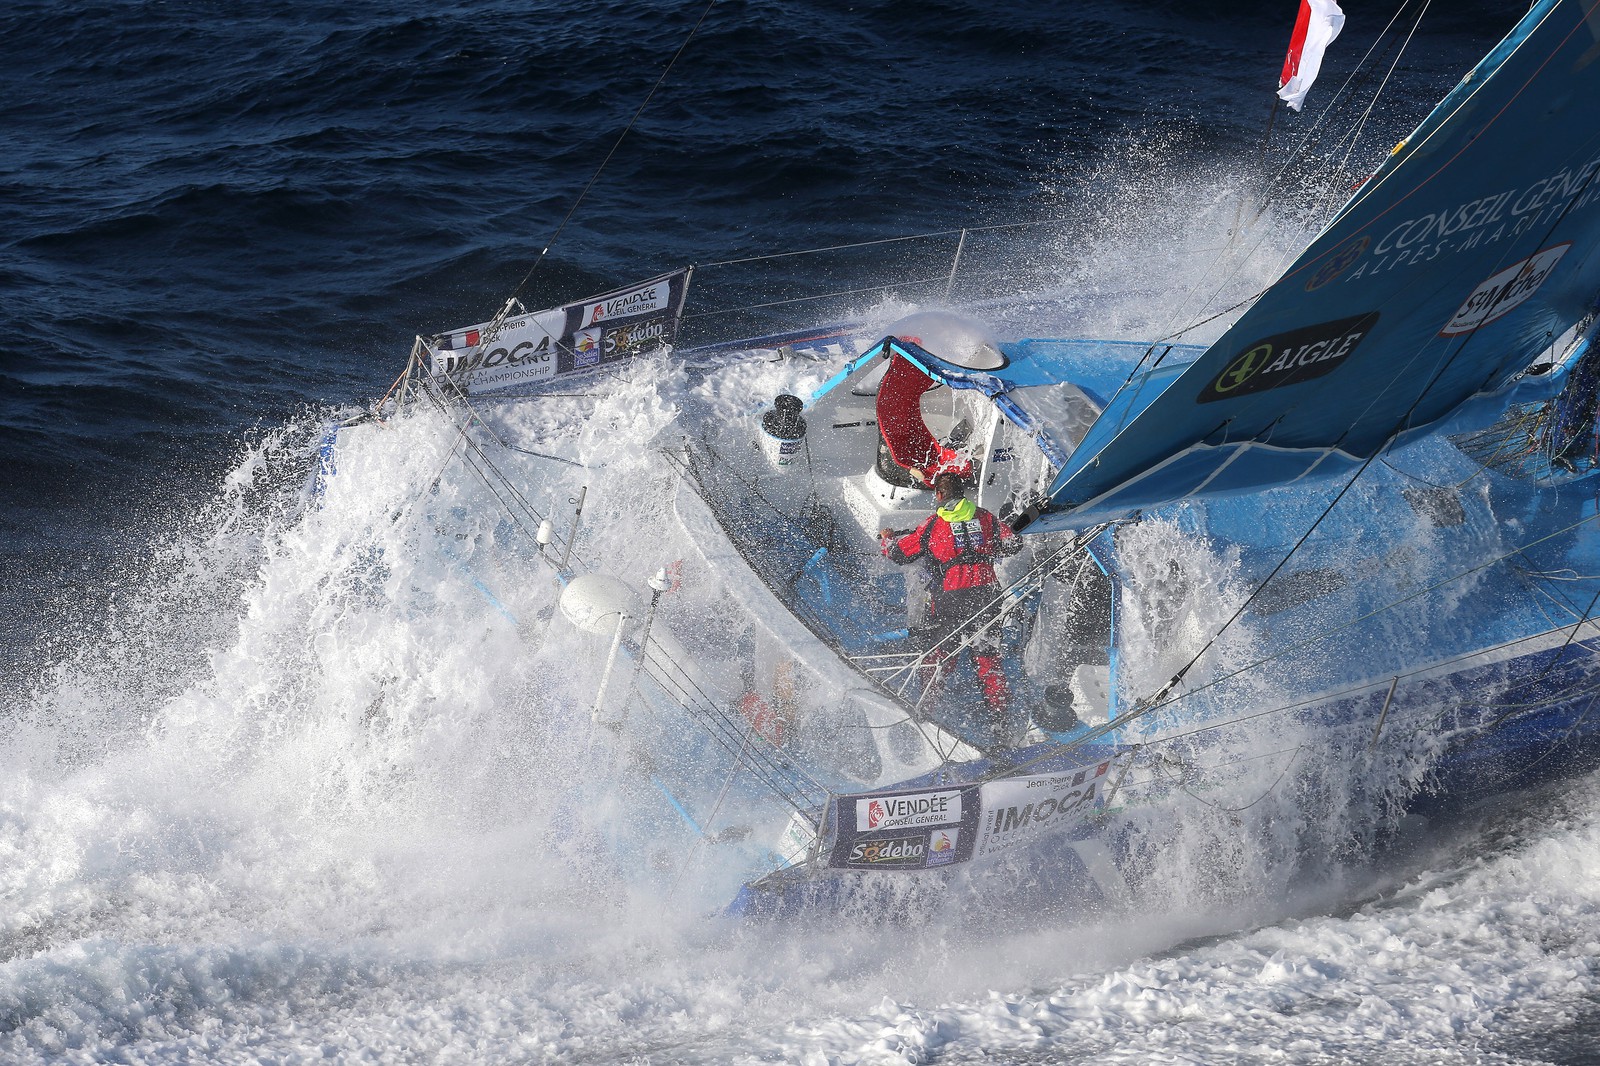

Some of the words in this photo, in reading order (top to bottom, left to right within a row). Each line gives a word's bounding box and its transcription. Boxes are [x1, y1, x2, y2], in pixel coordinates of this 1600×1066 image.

[1374, 190, 1517, 255] CONSEIL
[1511, 155, 1600, 216] GÉNÉ
[606, 287, 657, 314] VENDÉE
[1262, 332, 1362, 374] AIGLE
[473, 365, 551, 386] CHAMPIONSHIP
[884, 795, 948, 817] VENDÉE
[993, 782, 1096, 835] IMOCA
[884, 817, 914, 827] CONSEIL
[850, 841, 923, 861] Sodebo
